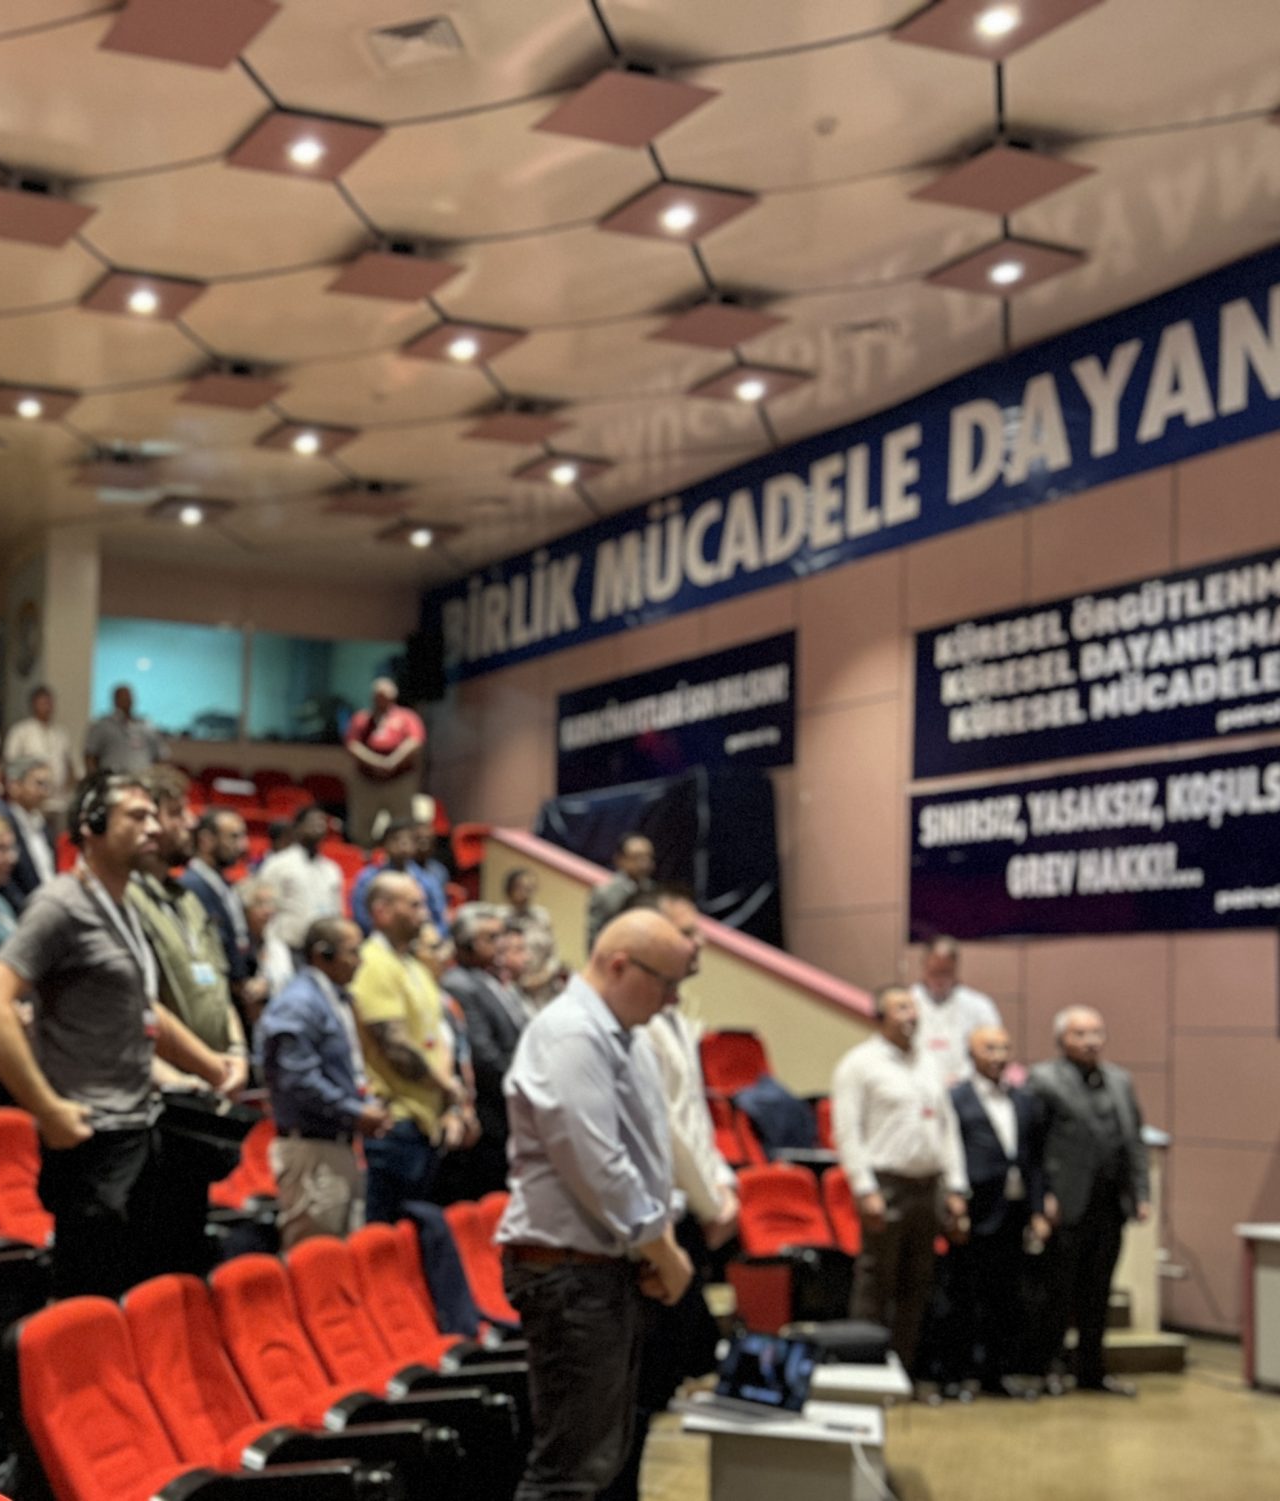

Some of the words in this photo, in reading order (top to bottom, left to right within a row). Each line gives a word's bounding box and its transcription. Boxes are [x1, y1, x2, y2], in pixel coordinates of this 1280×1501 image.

[442, 550, 581, 666] BİRLİK
[591, 421, 921, 621] MÜCADELE
[947, 283, 1280, 506] DAYAN
